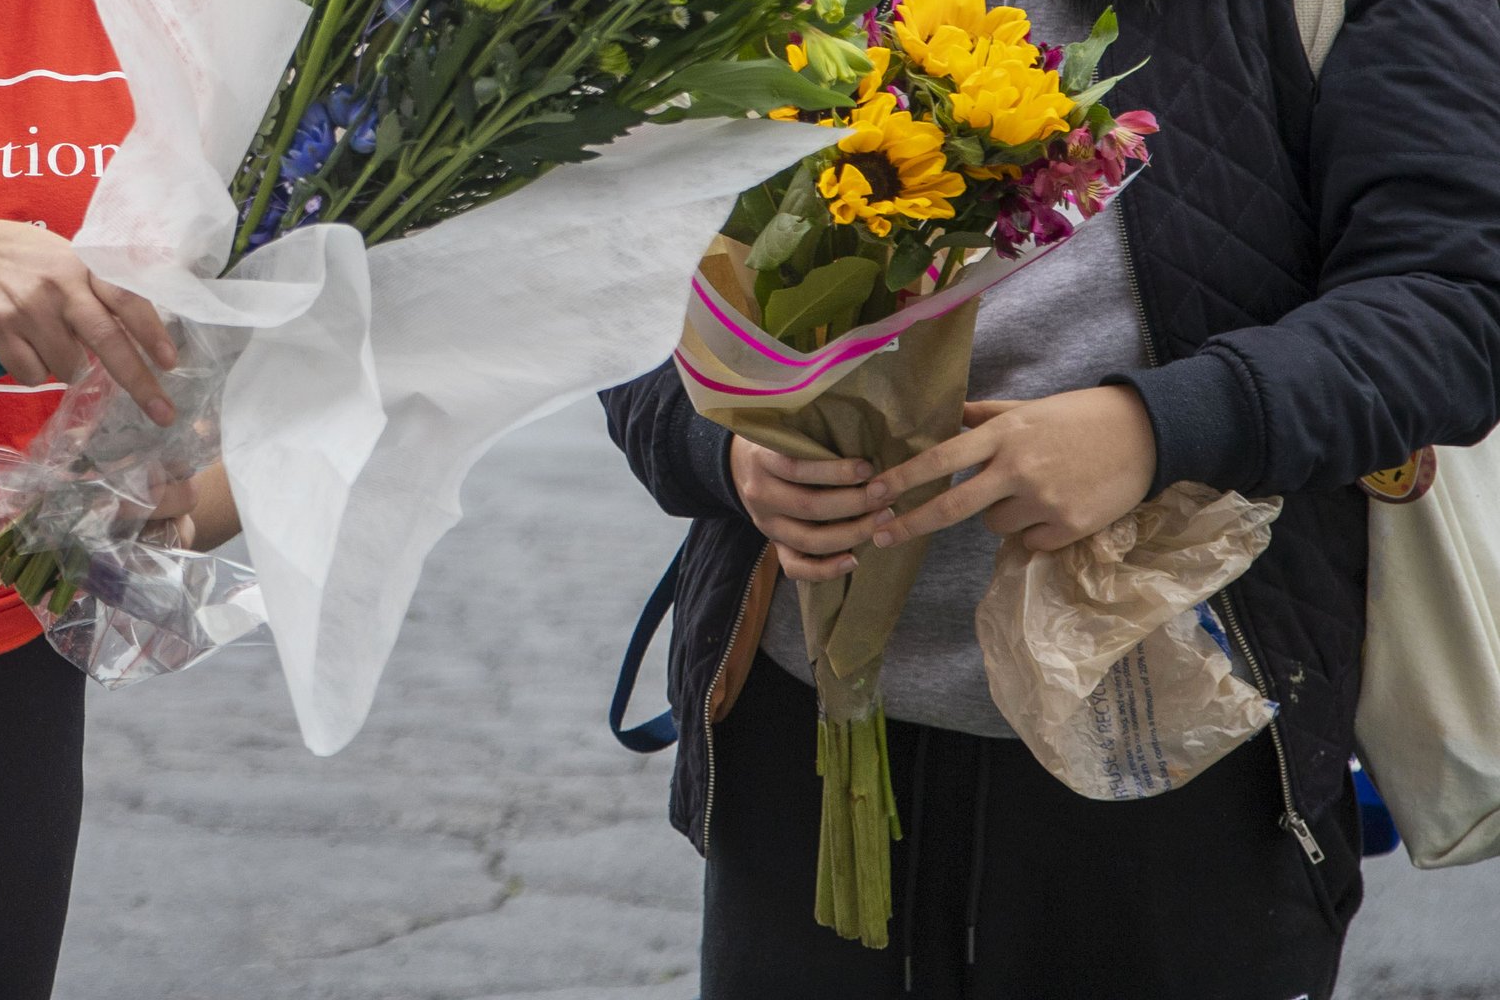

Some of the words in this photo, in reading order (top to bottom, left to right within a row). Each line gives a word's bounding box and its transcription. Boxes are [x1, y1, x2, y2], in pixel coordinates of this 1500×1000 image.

[1140, 676, 1150, 686] of
[1091, 678, 1112, 734] RECYCL
[1117, 700, 1126, 715] and
[1100, 737, 1115, 751] &
[1135, 744, 1143, 753] to
[1102, 754, 1129, 799] REUSE
[1140, 764, 1155, 789] return
